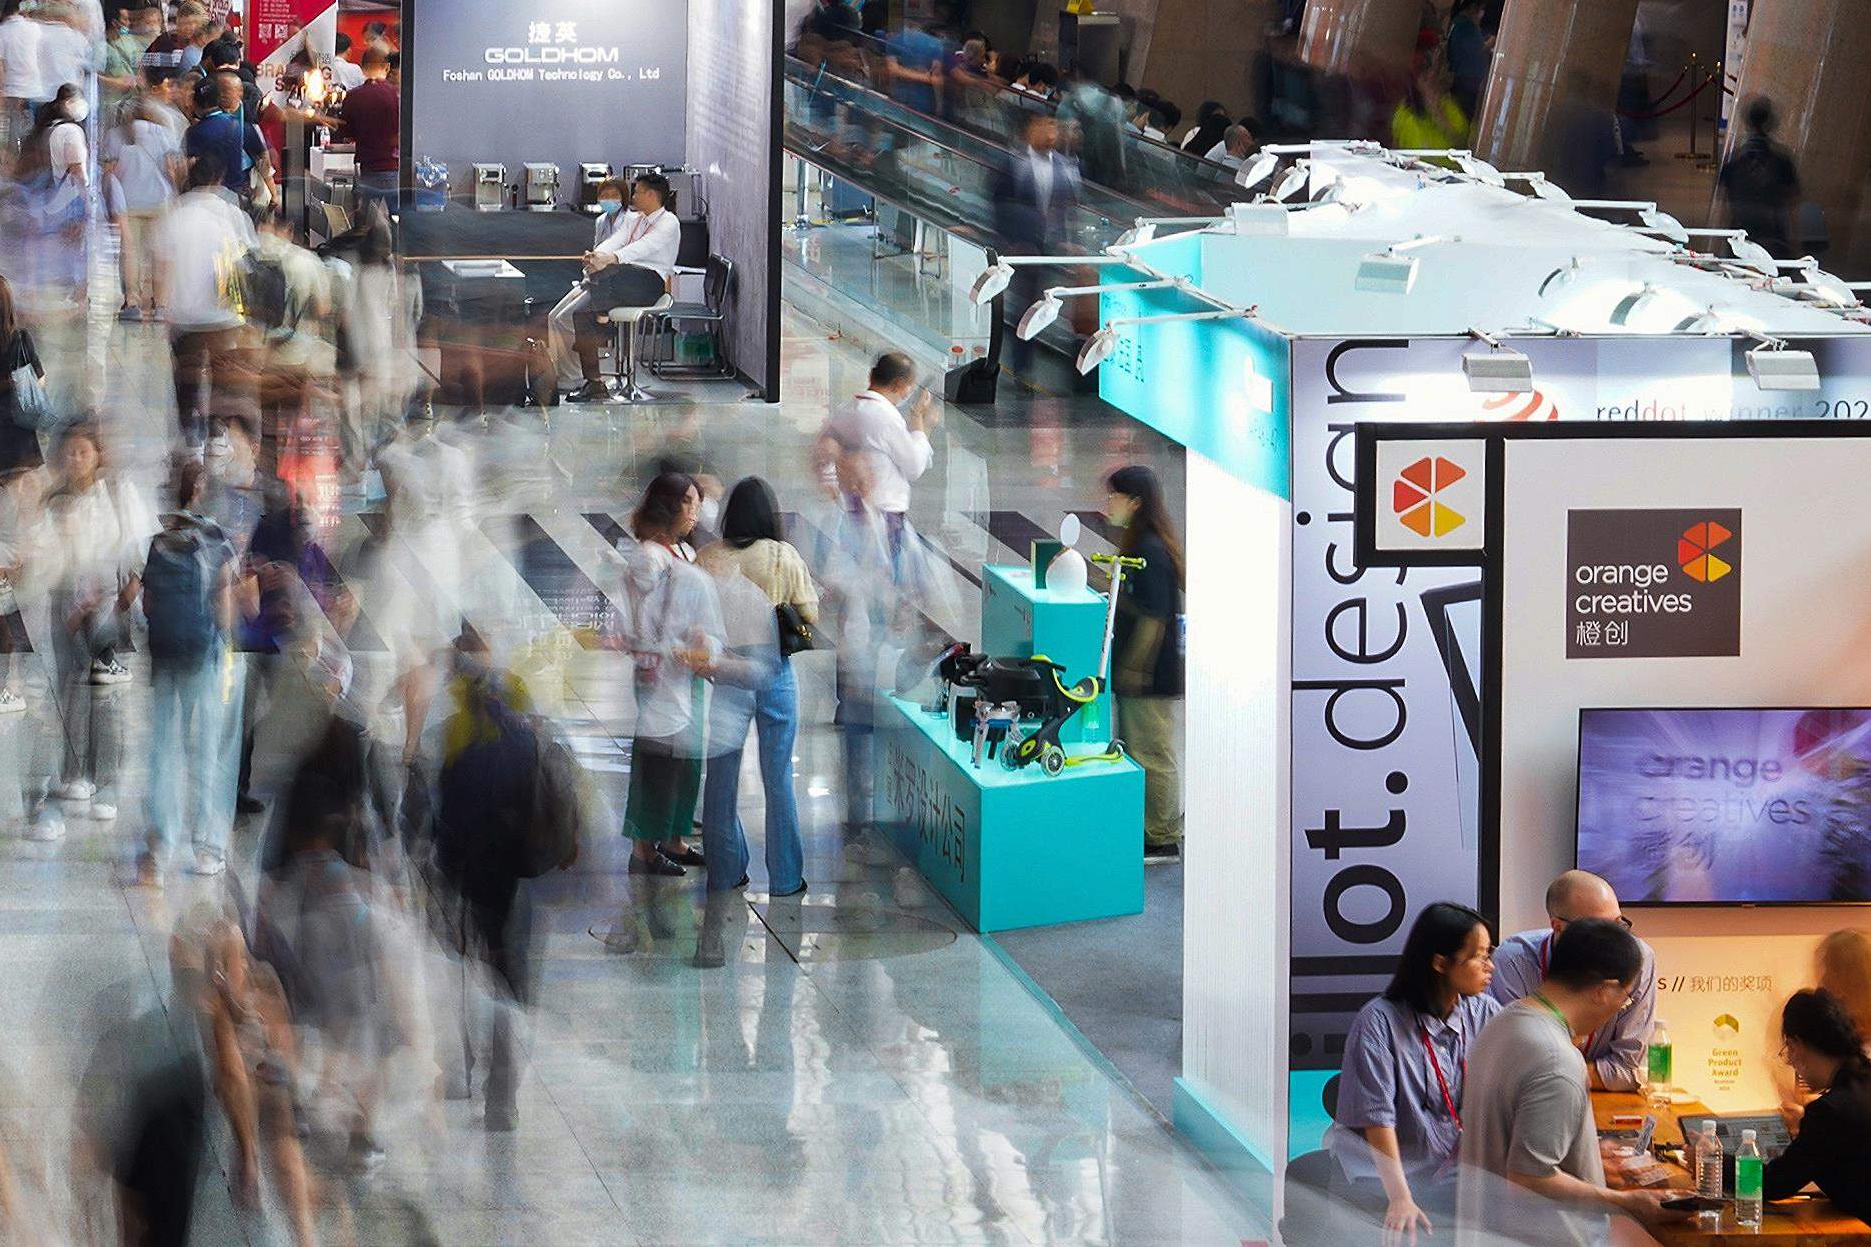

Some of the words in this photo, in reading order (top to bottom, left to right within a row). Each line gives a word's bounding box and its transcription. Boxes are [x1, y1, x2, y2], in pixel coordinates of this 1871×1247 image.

[484, 46, 620, 64] GOLDHOM
[443, 69, 483, 82] Foshan
[487, 67, 534, 82] GOLDHOM
[538, 68, 604, 83] Technology
[639, 67, 660, 80] Ltd
[1575, 564, 1670, 591] orange
[1575, 588, 1693, 614] creatives
[1575, 619, 1629, 647] 橙创
[1689, 975, 1773, 993] 我们的奖项
[1712, 1048, 1739, 1058] Green
[1707, 1058, 1742, 1068] Product
[1711, 1068, 1739, 1078] Award
